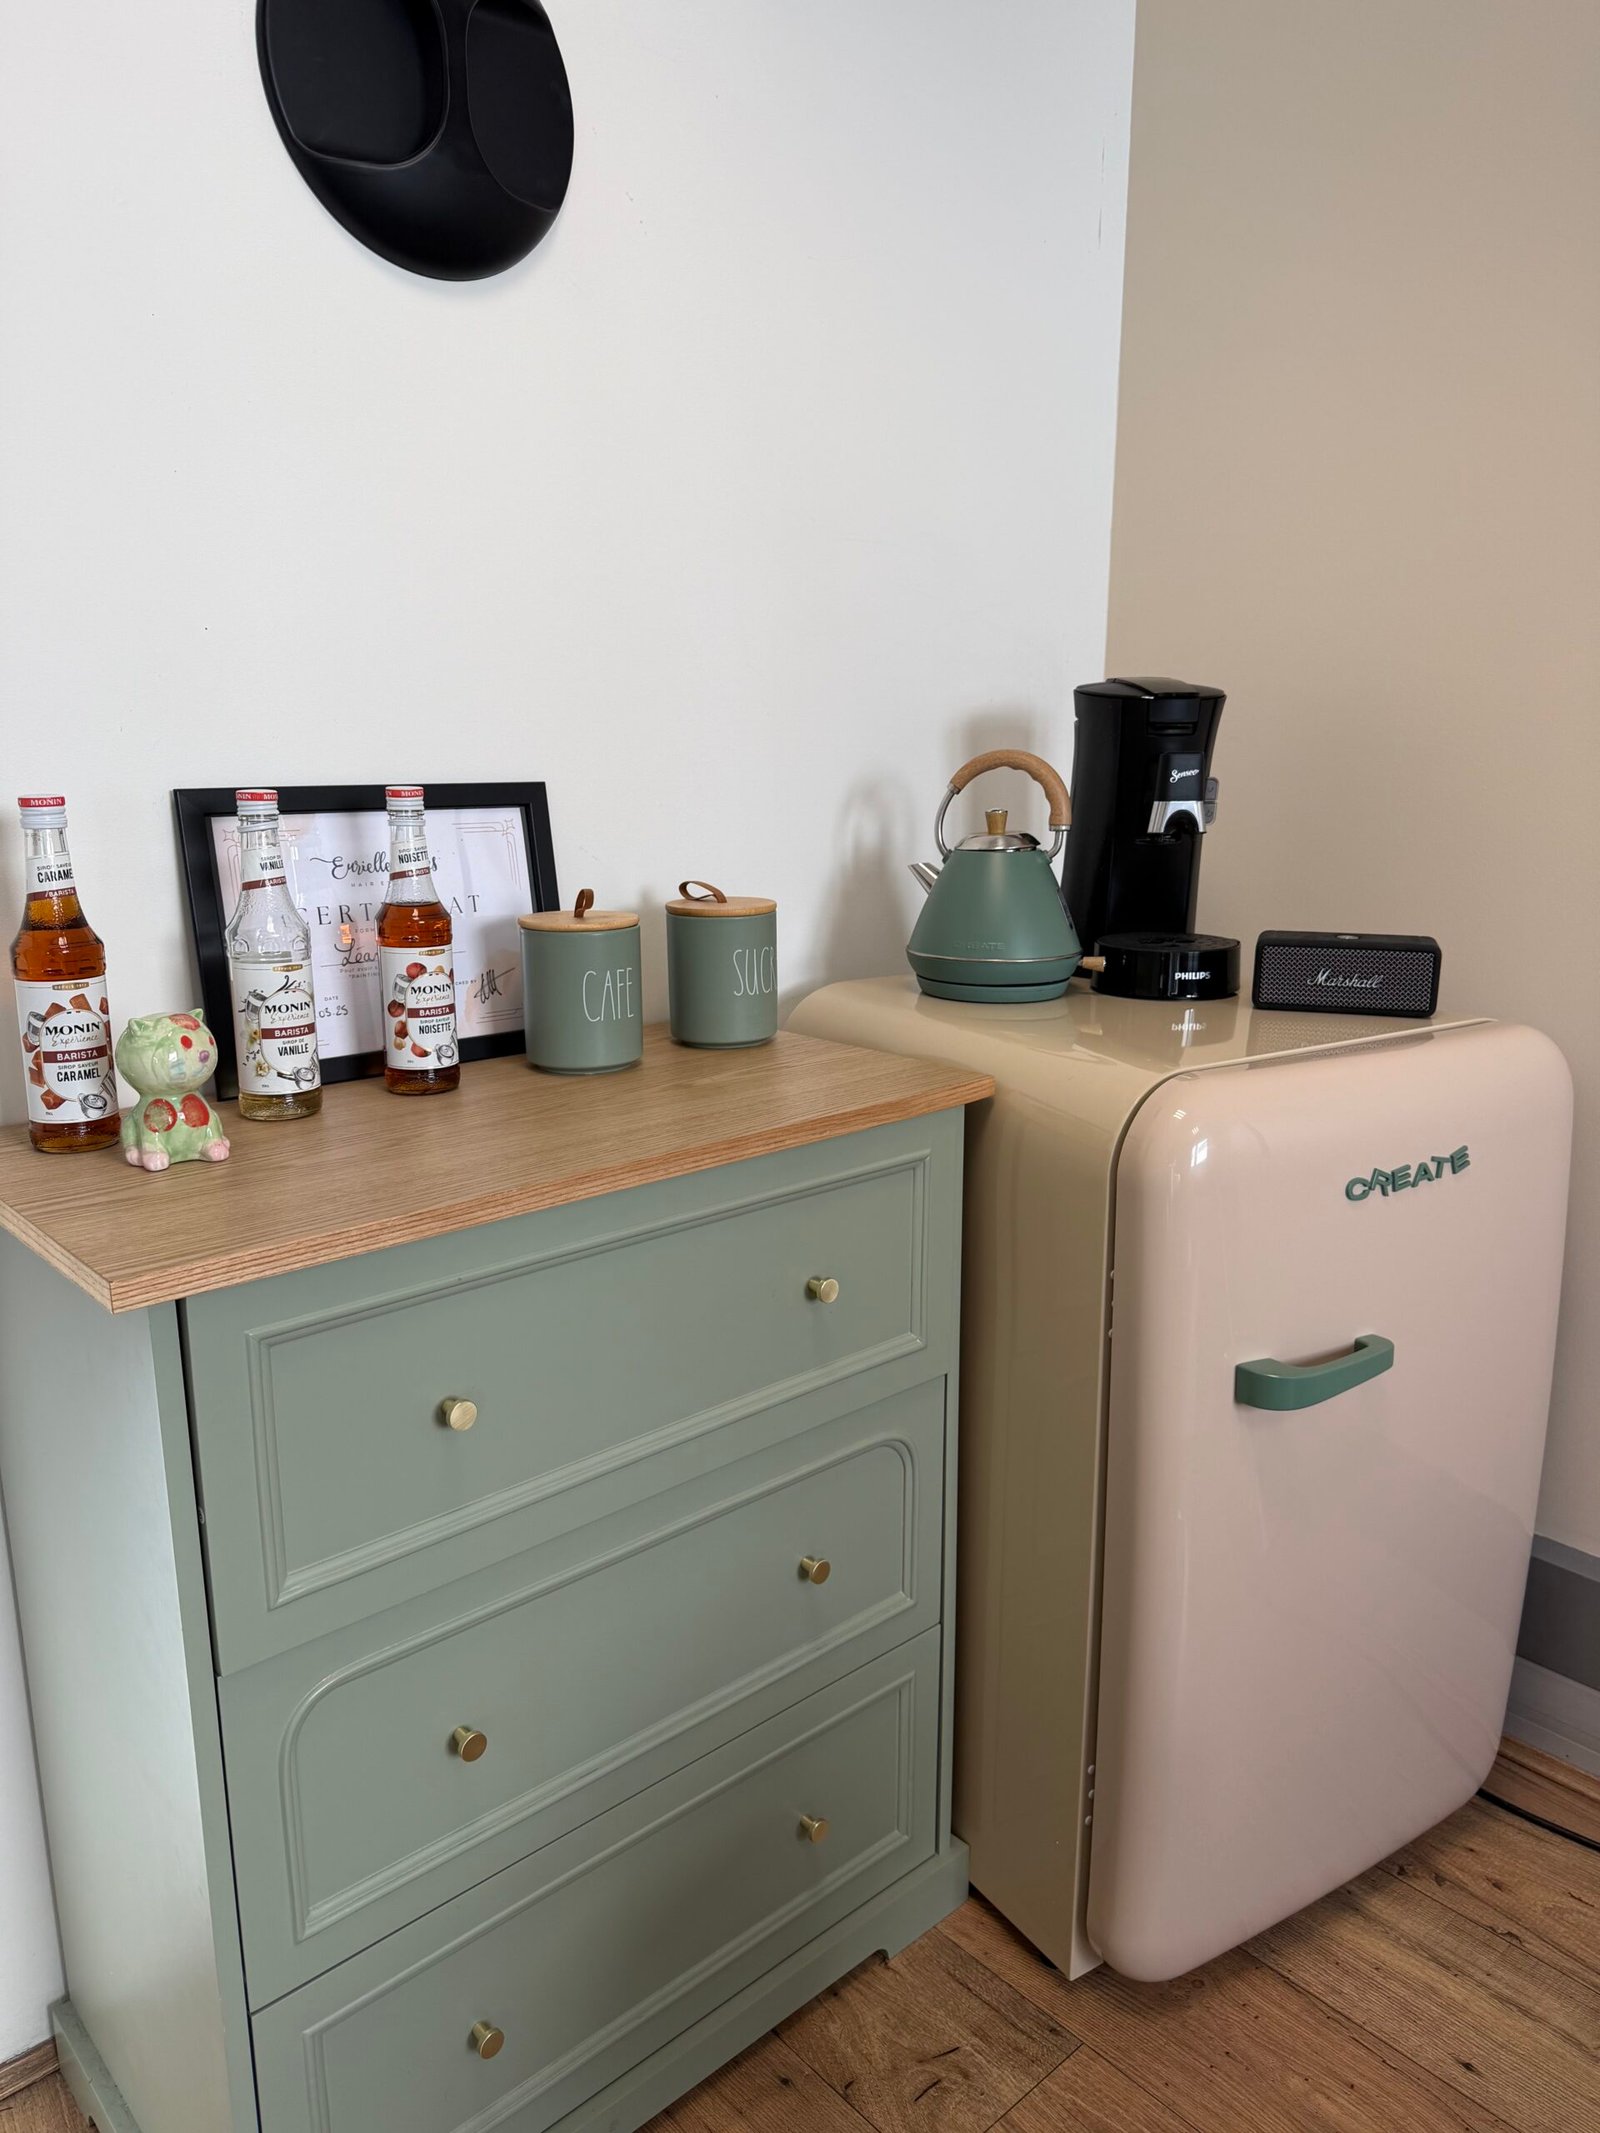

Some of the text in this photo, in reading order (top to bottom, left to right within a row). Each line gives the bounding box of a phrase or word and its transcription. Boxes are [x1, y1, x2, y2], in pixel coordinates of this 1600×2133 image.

[30, 798, 62, 806] MONIN
[1174, 972, 1211, 980] PHILIPS
[1307, 968, 1384, 988] Marshall
[410, 983, 451, 995] MONIN
[583, 967, 634, 1022] CAFE
[264, 1002, 310, 1015] MONIN
[45, 1021, 101, 1036] MONIN
[274, 1026, 309, 1038] BARISTA
[419, 1022, 452, 1035] NOISETTE
[277, 1042, 309, 1057] VANILLE
[56, 1052, 98, 1061] BARISTA
[56, 1066, 101, 1082] CARAMEL
[1345, 1145, 1471, 1201] CREATE
